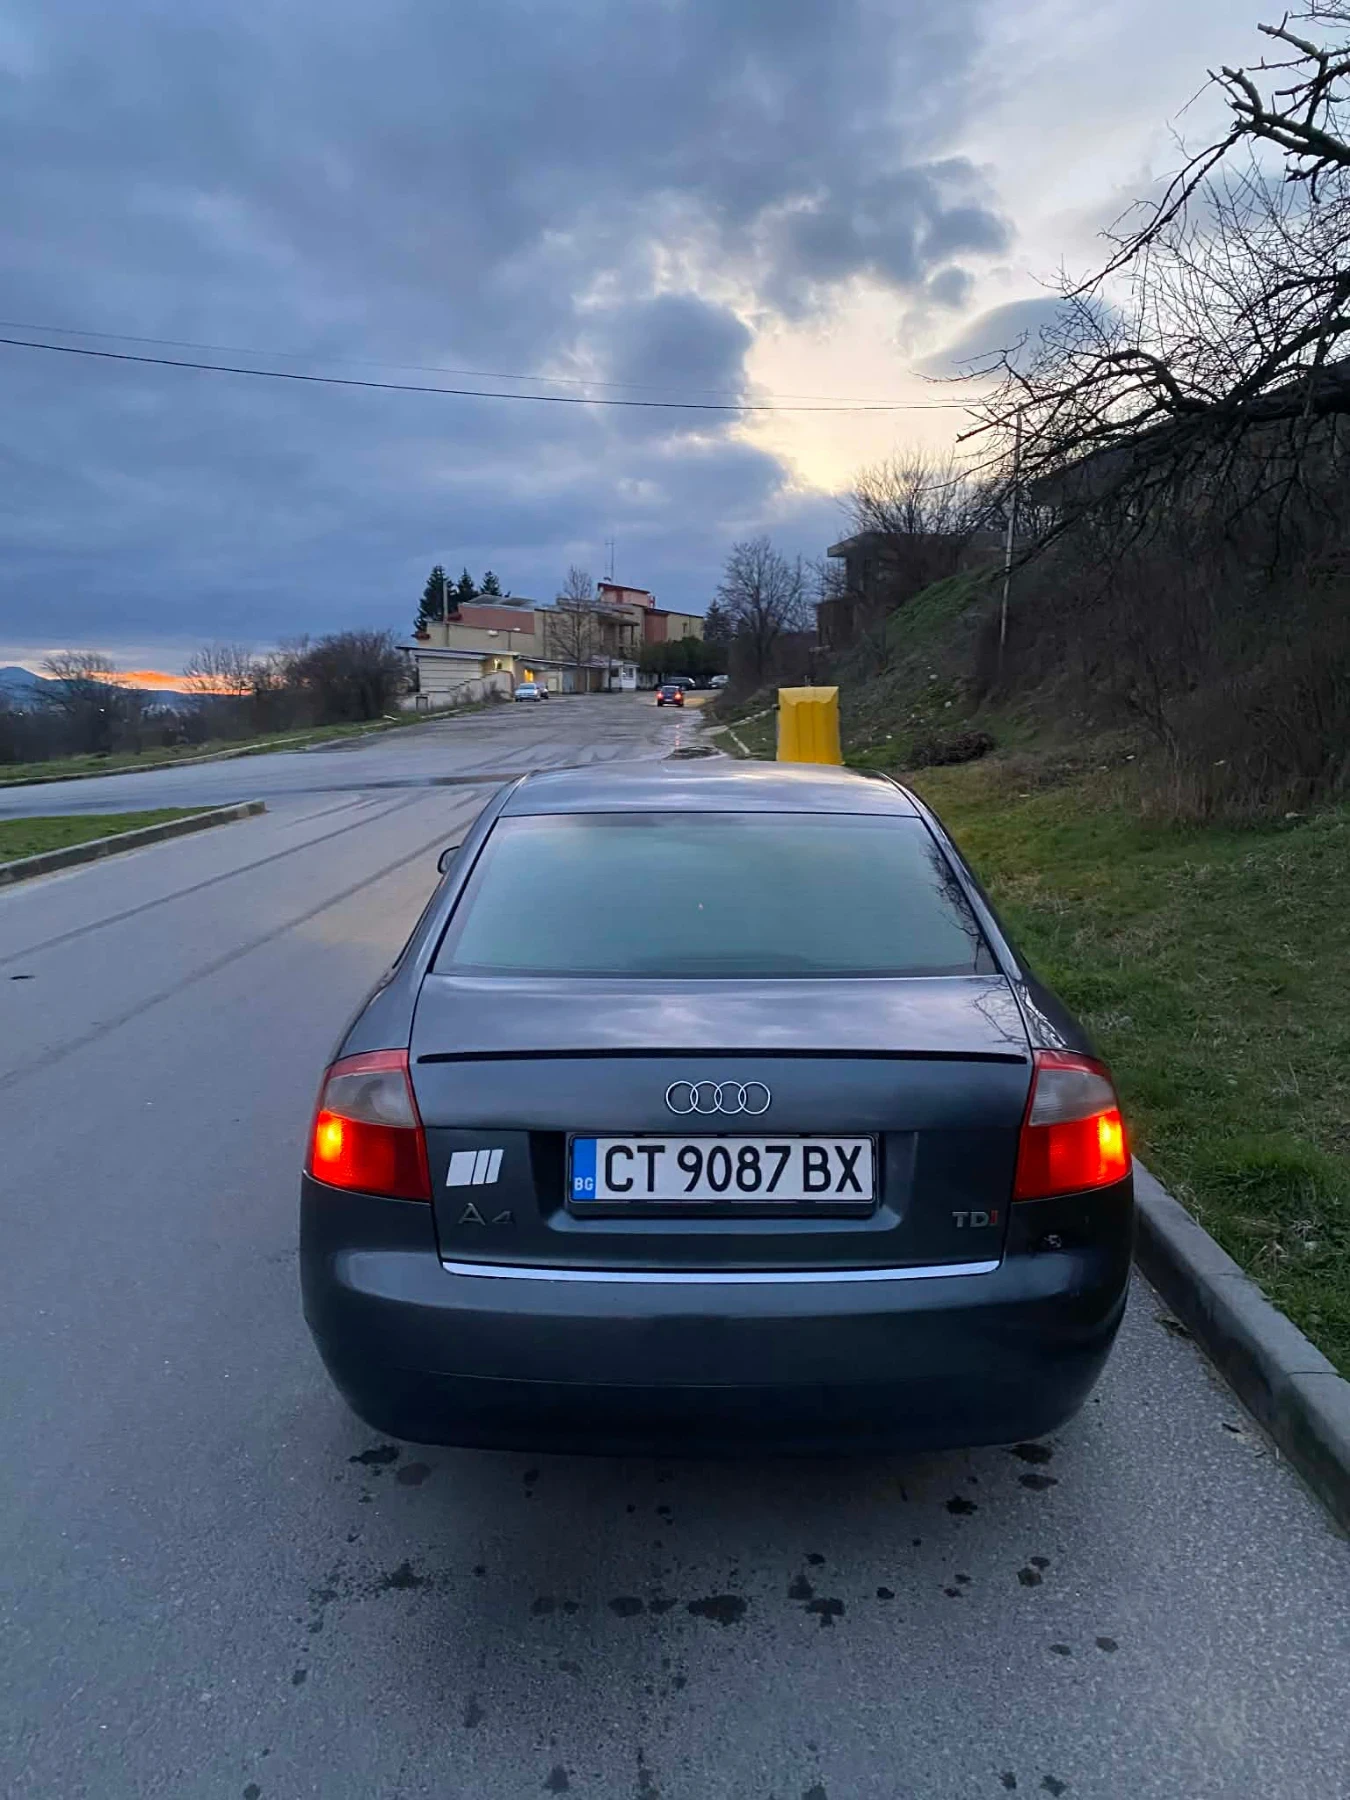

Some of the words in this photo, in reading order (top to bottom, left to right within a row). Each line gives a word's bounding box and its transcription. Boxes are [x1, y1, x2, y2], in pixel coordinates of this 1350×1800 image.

[605, 1145, 665, 1192] CT
[677, 1145, 791, 1192] 9087
[803, 1145, 863, 1192] BX
[574, 1178, 594, 1191] BG
[458, 1202, 513, 1226] A4
[952, 1210, 999, 1228] TDI
